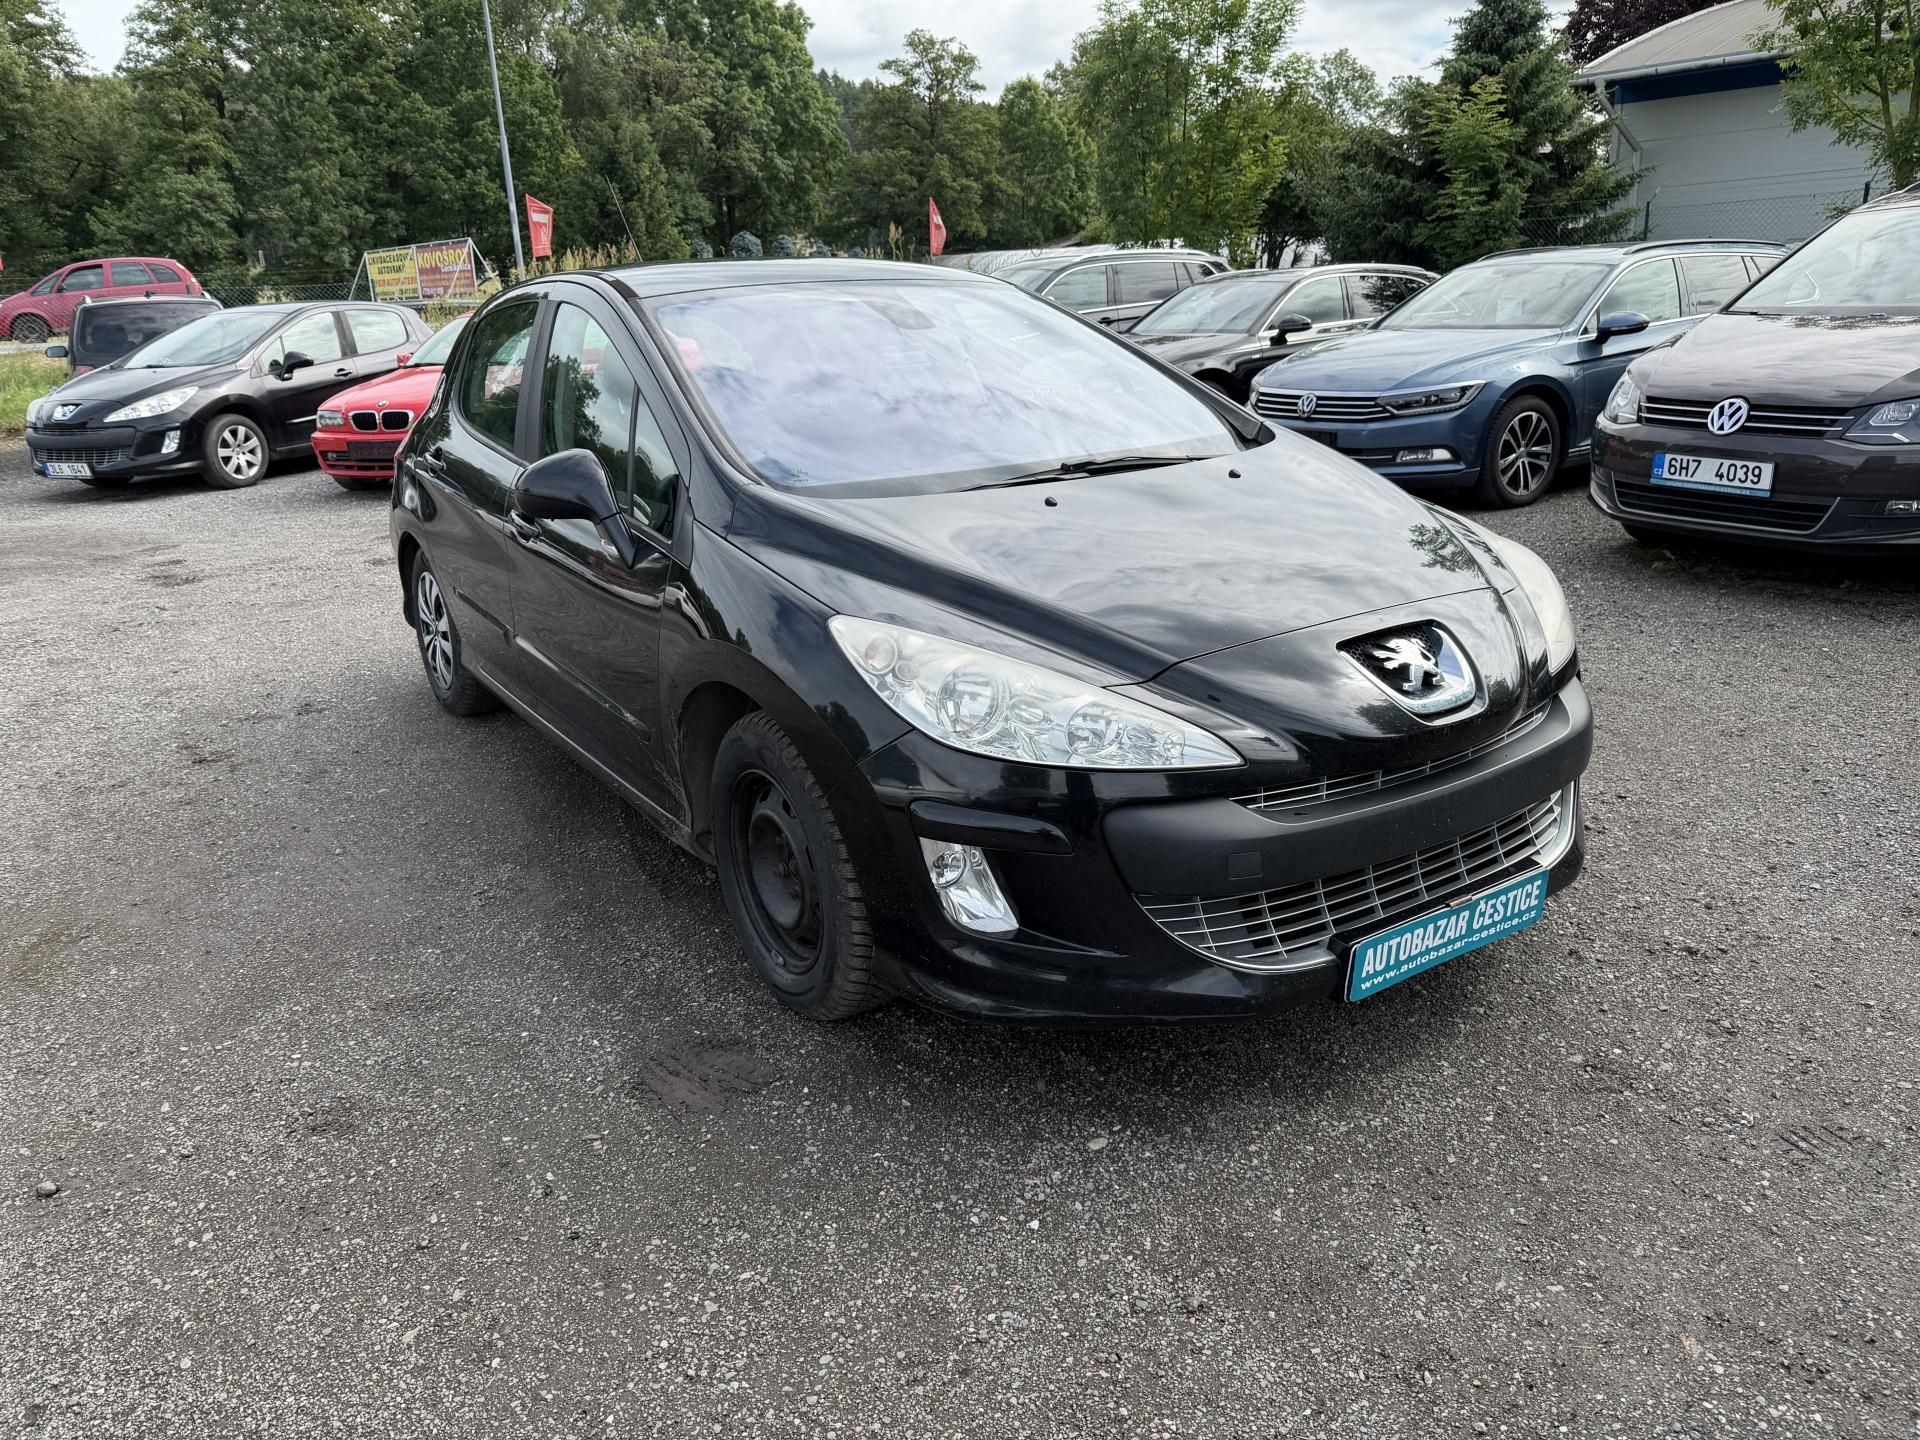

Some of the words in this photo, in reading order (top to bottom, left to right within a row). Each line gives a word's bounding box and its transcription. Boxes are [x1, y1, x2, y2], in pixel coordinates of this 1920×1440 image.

[417, 246, 469, 269] KOVOŠROT
[67, 464, 87, 475] 1641
[1653, 467, 1662, 475] CZ
[1667, 457, 1702, 478] 6H7
[1714, 462, 1762, 485] 4039
[1361, 910, 1469, 978] AUTOBAZAR
[1472, 880, 1542, 930] ČESTICE
[1360, 911, 1537, 990] www.autobazar-cestice.cz
